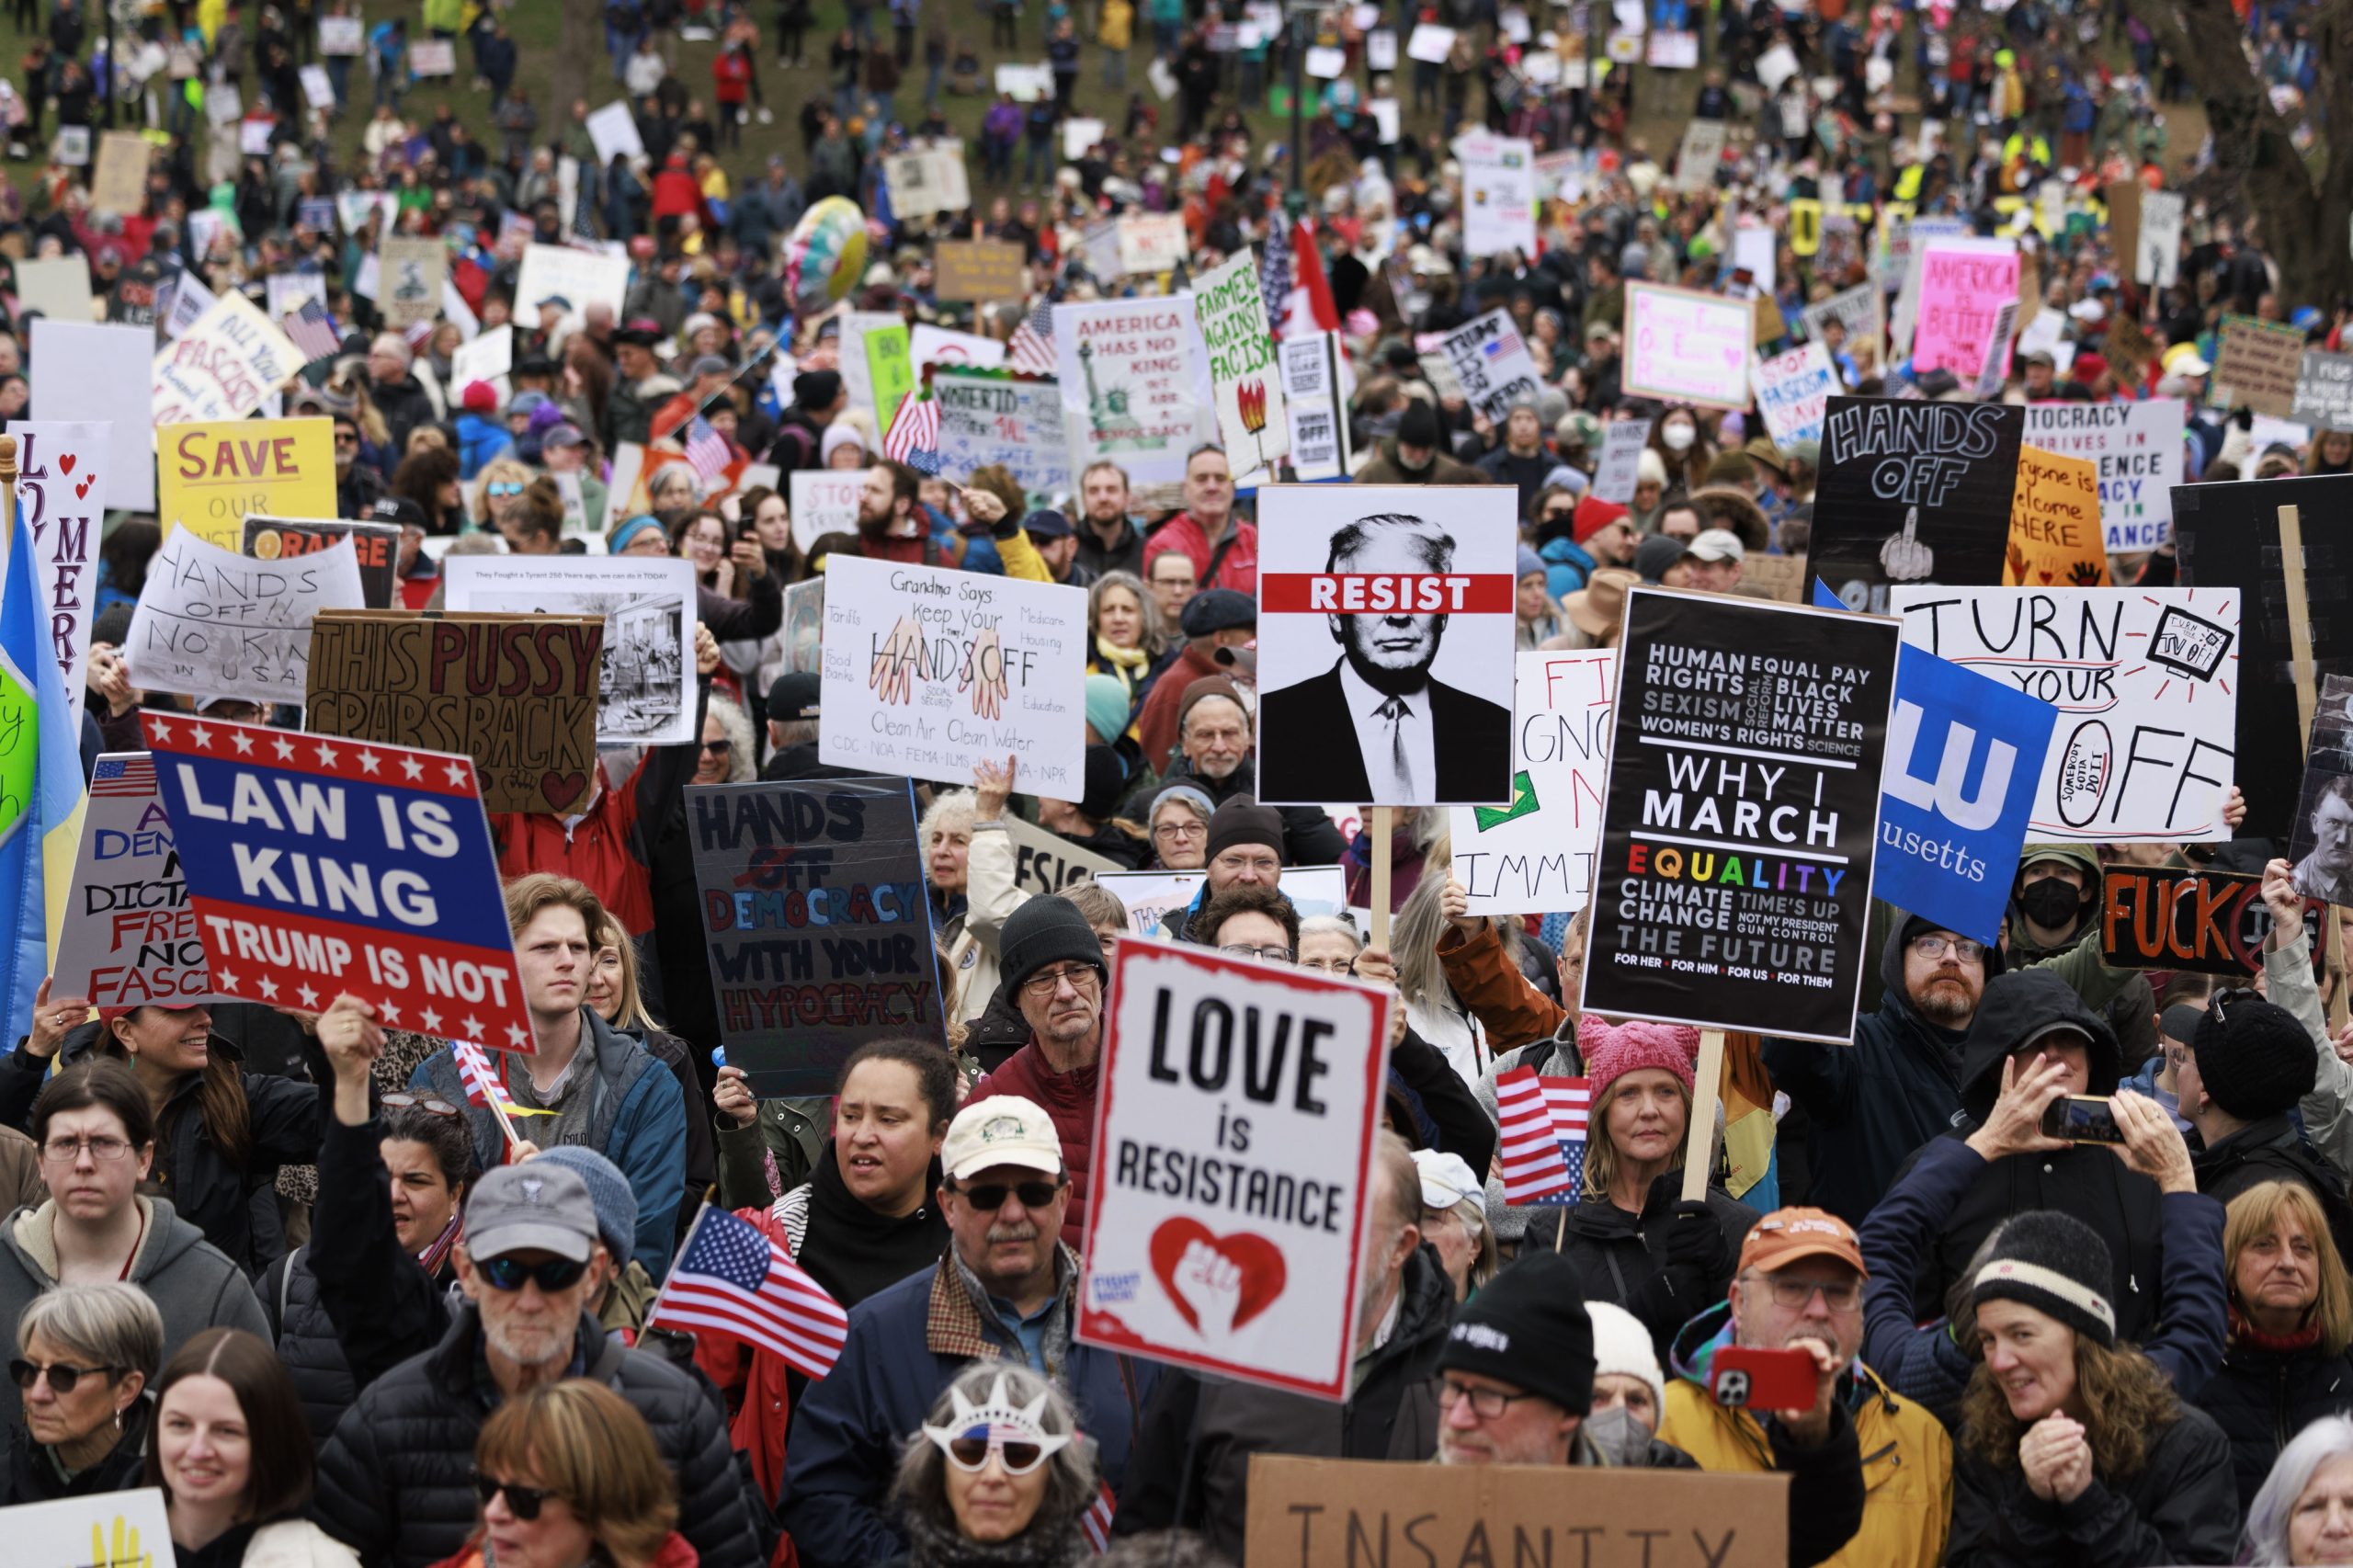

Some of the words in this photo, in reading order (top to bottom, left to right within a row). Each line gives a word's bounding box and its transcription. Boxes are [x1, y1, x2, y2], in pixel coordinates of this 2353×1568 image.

[218, 313, 258, 347] ALL
[1077, 313, 1181, 337] AMERICA
[1206, 296, 1260, 351] AGAINST
[1444, 317, 1500, 355] TRUMP
[1098, 341, 1137, 356] HAS
[1146, 337, 1176, 351] NO
[1211, 333, 1276, 384] FACISM
[1131, 358, 1181, 373] KING
[1088, 424, 1191, 443] DEMOCRACY
[1828, 404, 2006, 464] HANDS
[2027, 405, 2131, 430] TOCRACY
[178, 432, 300, 479] SAVE
[2024, 435, 2106, 450] THRIVES
[2126, 433, 2145, 447] IN
[1871, 456, 1971, 507] OFF
[2077, 472, 2094, 493] is
[210, 494, 268, 518] OUR
[2124, 504, 2143, 517] IN
[2012, 509, 2083, 548] HERE
[154, 544, 320, 600] HANDS
[475, 571, 493, 580] They
[494, 571, 518, 581] Fought
[526, 572, 548, 581] Tyrant
[891, 571, 951, 598] Grandma
[186, 598, 294, 622] OFF!!
[1310, 576, 1471, 610] RESIST
[827, 606, 861, 626] Tariffs
[912, 602, 951, 634] Keep
[961, 609, 1003, 634] your
[1019, 607, 1065, 626] Medicare
[1904, 595, 2123, 661] TURN
[2170, 617, 2198, 631] TURN
[147, 620, 209, 654] NO
[1020, 631, 1062, 654] Housing
[2161, 633, 2187, 655] TV
[2188, 643, 2214, 666] OFF
[313, 623, 421, 693] THIS
[430, 622, 603, 696] PUSSY
[825, 649, 852, 666] Food
[825, 665, 855, 683] Banks
[871, 632, 975, 682] HANDS
[981, 645, 1038, 687] OFF
[1648, 643, 1746, 674] HUMAN
[1751, 656, 1821, 679] EQUAL
[1831, 666, 1871, 686] PAY
[174, 665, 195, 676] IN
[222, 664, 302, 686] U.S.A.
[1645, 665, 1744, 696] RIGHTS
[1776, 677, 1853, 703] BLACK
[2012, 669, 2116, 704] YOUR
[921, 695, 954, 711] SECURITY
[926, 686, 952, 699] SOCIAL
[1023, 696, 1066, 714] Education
[1643, 690, 1741, 722] SEXISM
[1745, 677, 1761, 727] SOCIAL
[1757, 675, 1774, 729] REFORM
[1774, 694, 1840, 720] LIVES
[311, 691, 460, 750] GRABS
[465, 696, 592, 769] BACK
[871, 711, 912, 737] Clean
[915, 717, 936, 740] Air
[948, 720, 987, 748] Clean
[992, 726, 1034, 752] Water
[1641, 714, 1731, 742] WOMEN'S
[1736, 727, 1804, 750] RIGHTS
[1807, 739, 1861, 757] SCIENCE
[1772, 714, 1864, 741] MATTER
[832, 735, 859, 754] CDC
[870, 741, 895, 757] NOA
[905, 748, 938, 765] FEMA
[1040, 767, 1066, 784] NPR
[2057, 719, 2234, 829] OFF
[2062, 743, 2082, 802] SOMEBODY
[2075, 759, 2086, 790] GOTTA
[2090, 751, 2103, 772] IT
[1666, 752, 1786, 801] WHY
[1813, 771, 1824, 808] I
[2086, 774, 2100, 794] DO
[177, 764, 347, 840] LAW
[377, 795, 460, 858] IS
[695, 790, 866, 851] HANDS
[1642, 789, 1839, 848] MARCH
[232, 843, 439, 926] KING
[738, 846, 834, 890] OFF
[1627, 844, 1846, 897] EQUALITY
[705, 882, 918, 932] DEMOCRACY
[1620, 879, 1733, 911] CLIMATE
[1740, 892, 1806, 916] TIME'S
[1813, 900, 1840, 919] UP
[1619, 899, 1731, 931] CHANGE
[1738, 912, 1762, 926] NOT
[1763, 915, 1780, 928] MY
[1781, 916, 1839, 934] PRESIDENT
[2104, 873, 2243, 961] FUCK
[1617, 924, 1682, 955] THE
[1700, 935, 1836, 974] FUTURE
[1736, 923, 1765, 937] GUN
[1771, 926, 1836, 945] CONTROL
[205, 915, 351, 977] TRUMP
[364, 944, 409, 989] IS
[418, 952, 509, 1008] NOT
[711, 938, 813, 983] WITH
[821, 934, 920, 979] YOUR
[1614, 952, 1638, 965] FOR
[1640, 955, 1662, 968] HER
[1671, 959, 1695, 971] FOR
[1697, 961, 1718, 974] HIM
[1727, 966, 1751, 979] FOR
[1753, 968, 1768, 981] US
[1777, 971, 1800, 984] FOR
[1802, 973, 1833, 989] THEM
[722, 982, 931, 1032] HYPOCRACY
[1149, 987, 1335, 1117] LOVE
[1216, 1101, 1250, 1153] is
[1117, 1139, 1345, 1233] RESISTANCE
[1288, 1504, 1737, 1568] INSANITY
